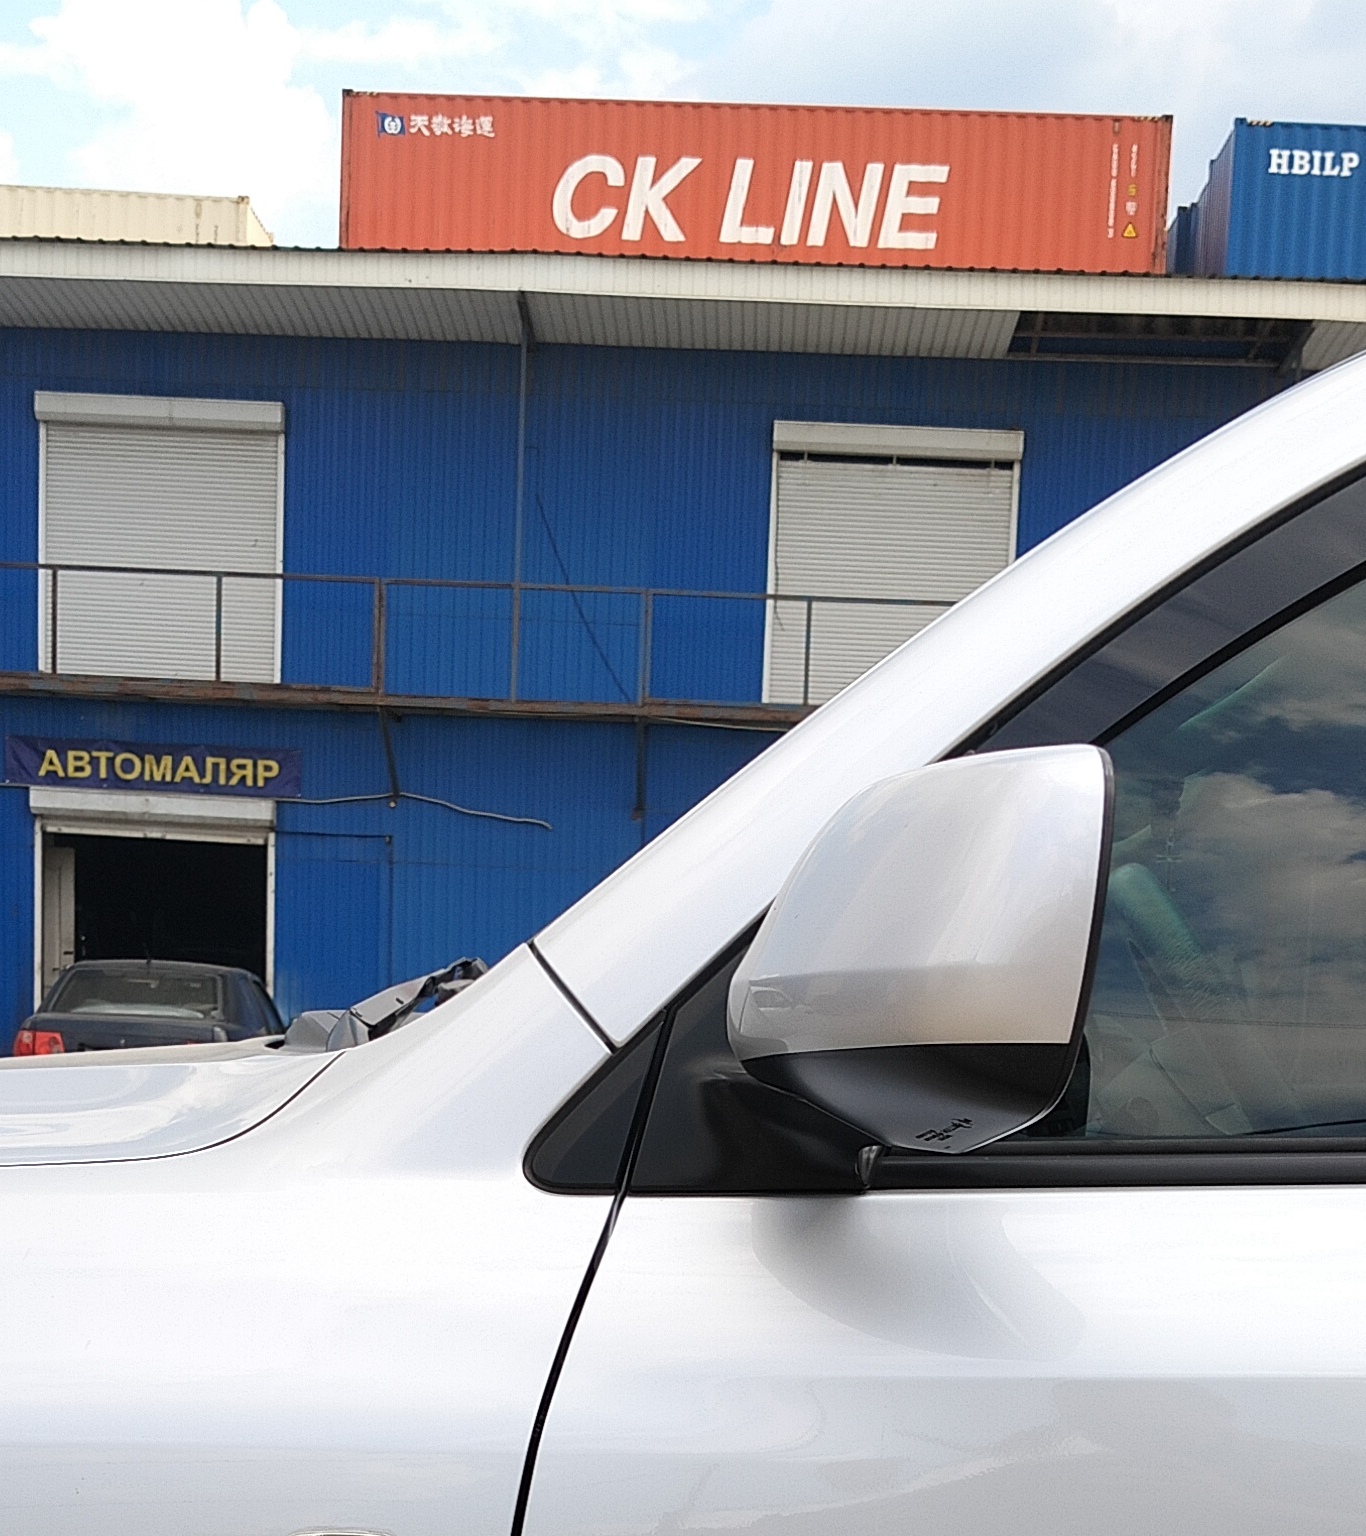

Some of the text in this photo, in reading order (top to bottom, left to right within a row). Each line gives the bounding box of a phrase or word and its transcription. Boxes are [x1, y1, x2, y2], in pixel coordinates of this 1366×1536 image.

[1268, 149, 1360, 178] HBILP
[552, 154, 951, 251] CK LINE
[38, 748, 281, 788] АВТОМАЛЯР
